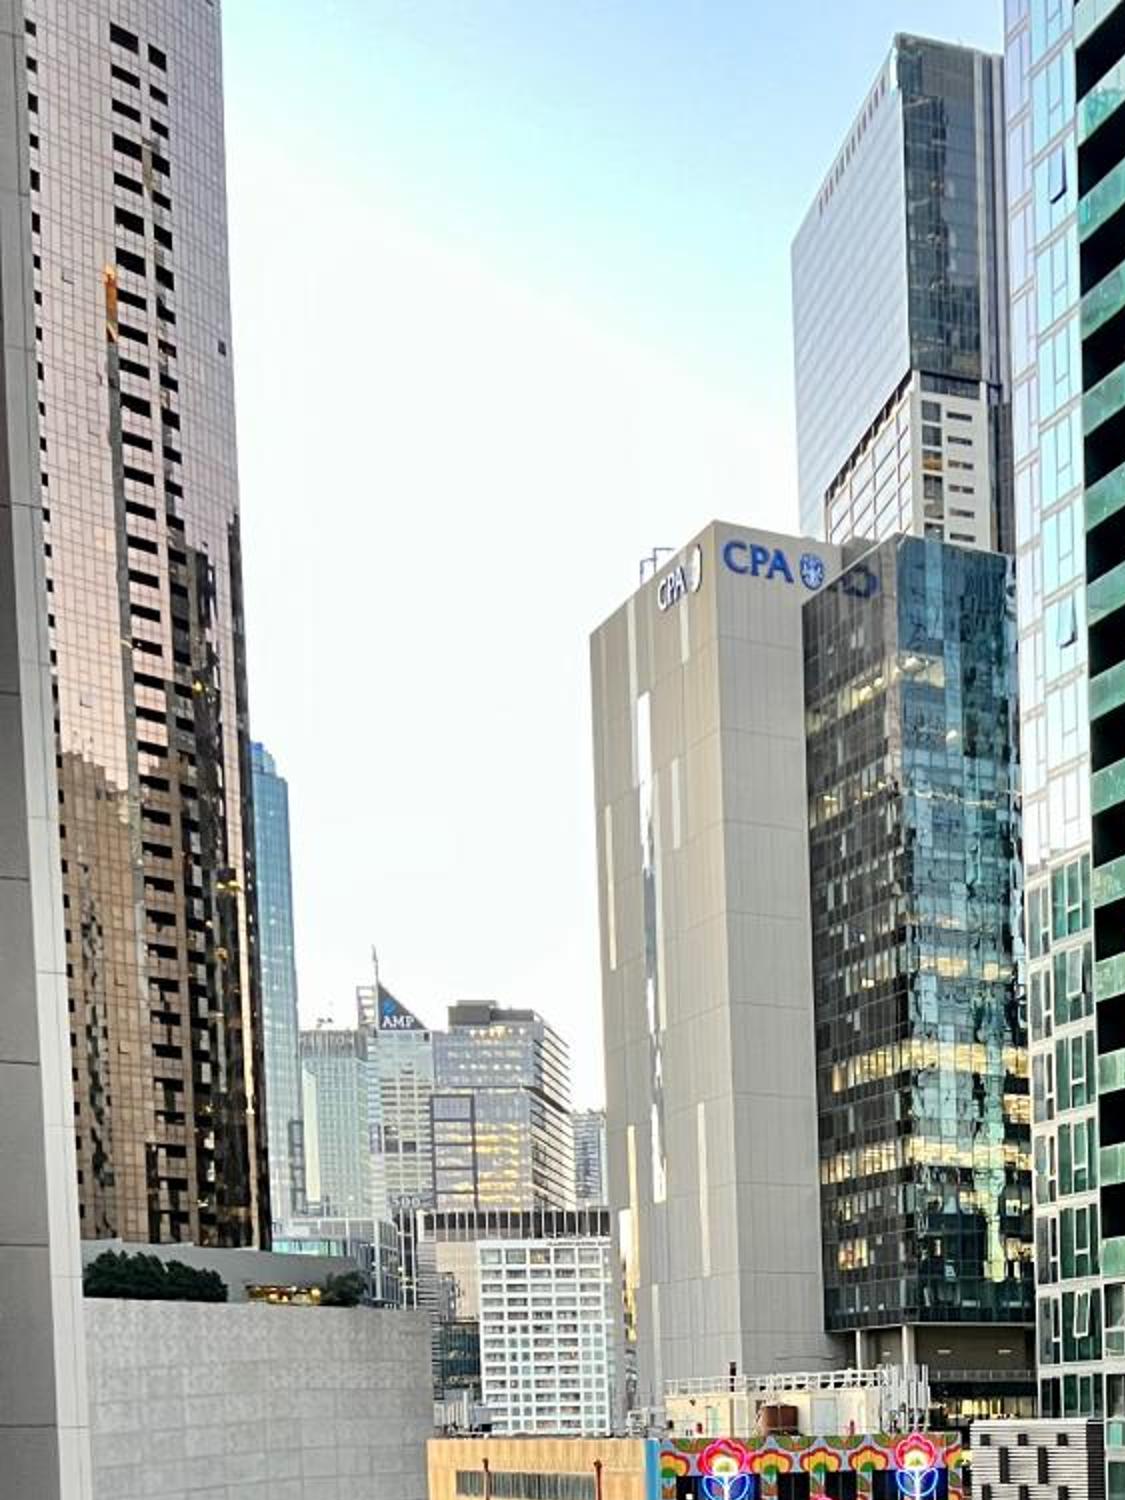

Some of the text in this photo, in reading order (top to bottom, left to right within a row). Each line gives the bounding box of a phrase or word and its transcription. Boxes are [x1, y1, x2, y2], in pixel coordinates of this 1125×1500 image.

[723, 540, 795, 585] CPA
[657, 565, 689, 612] CPA
[382, 1015, 415, 1029] AMP
